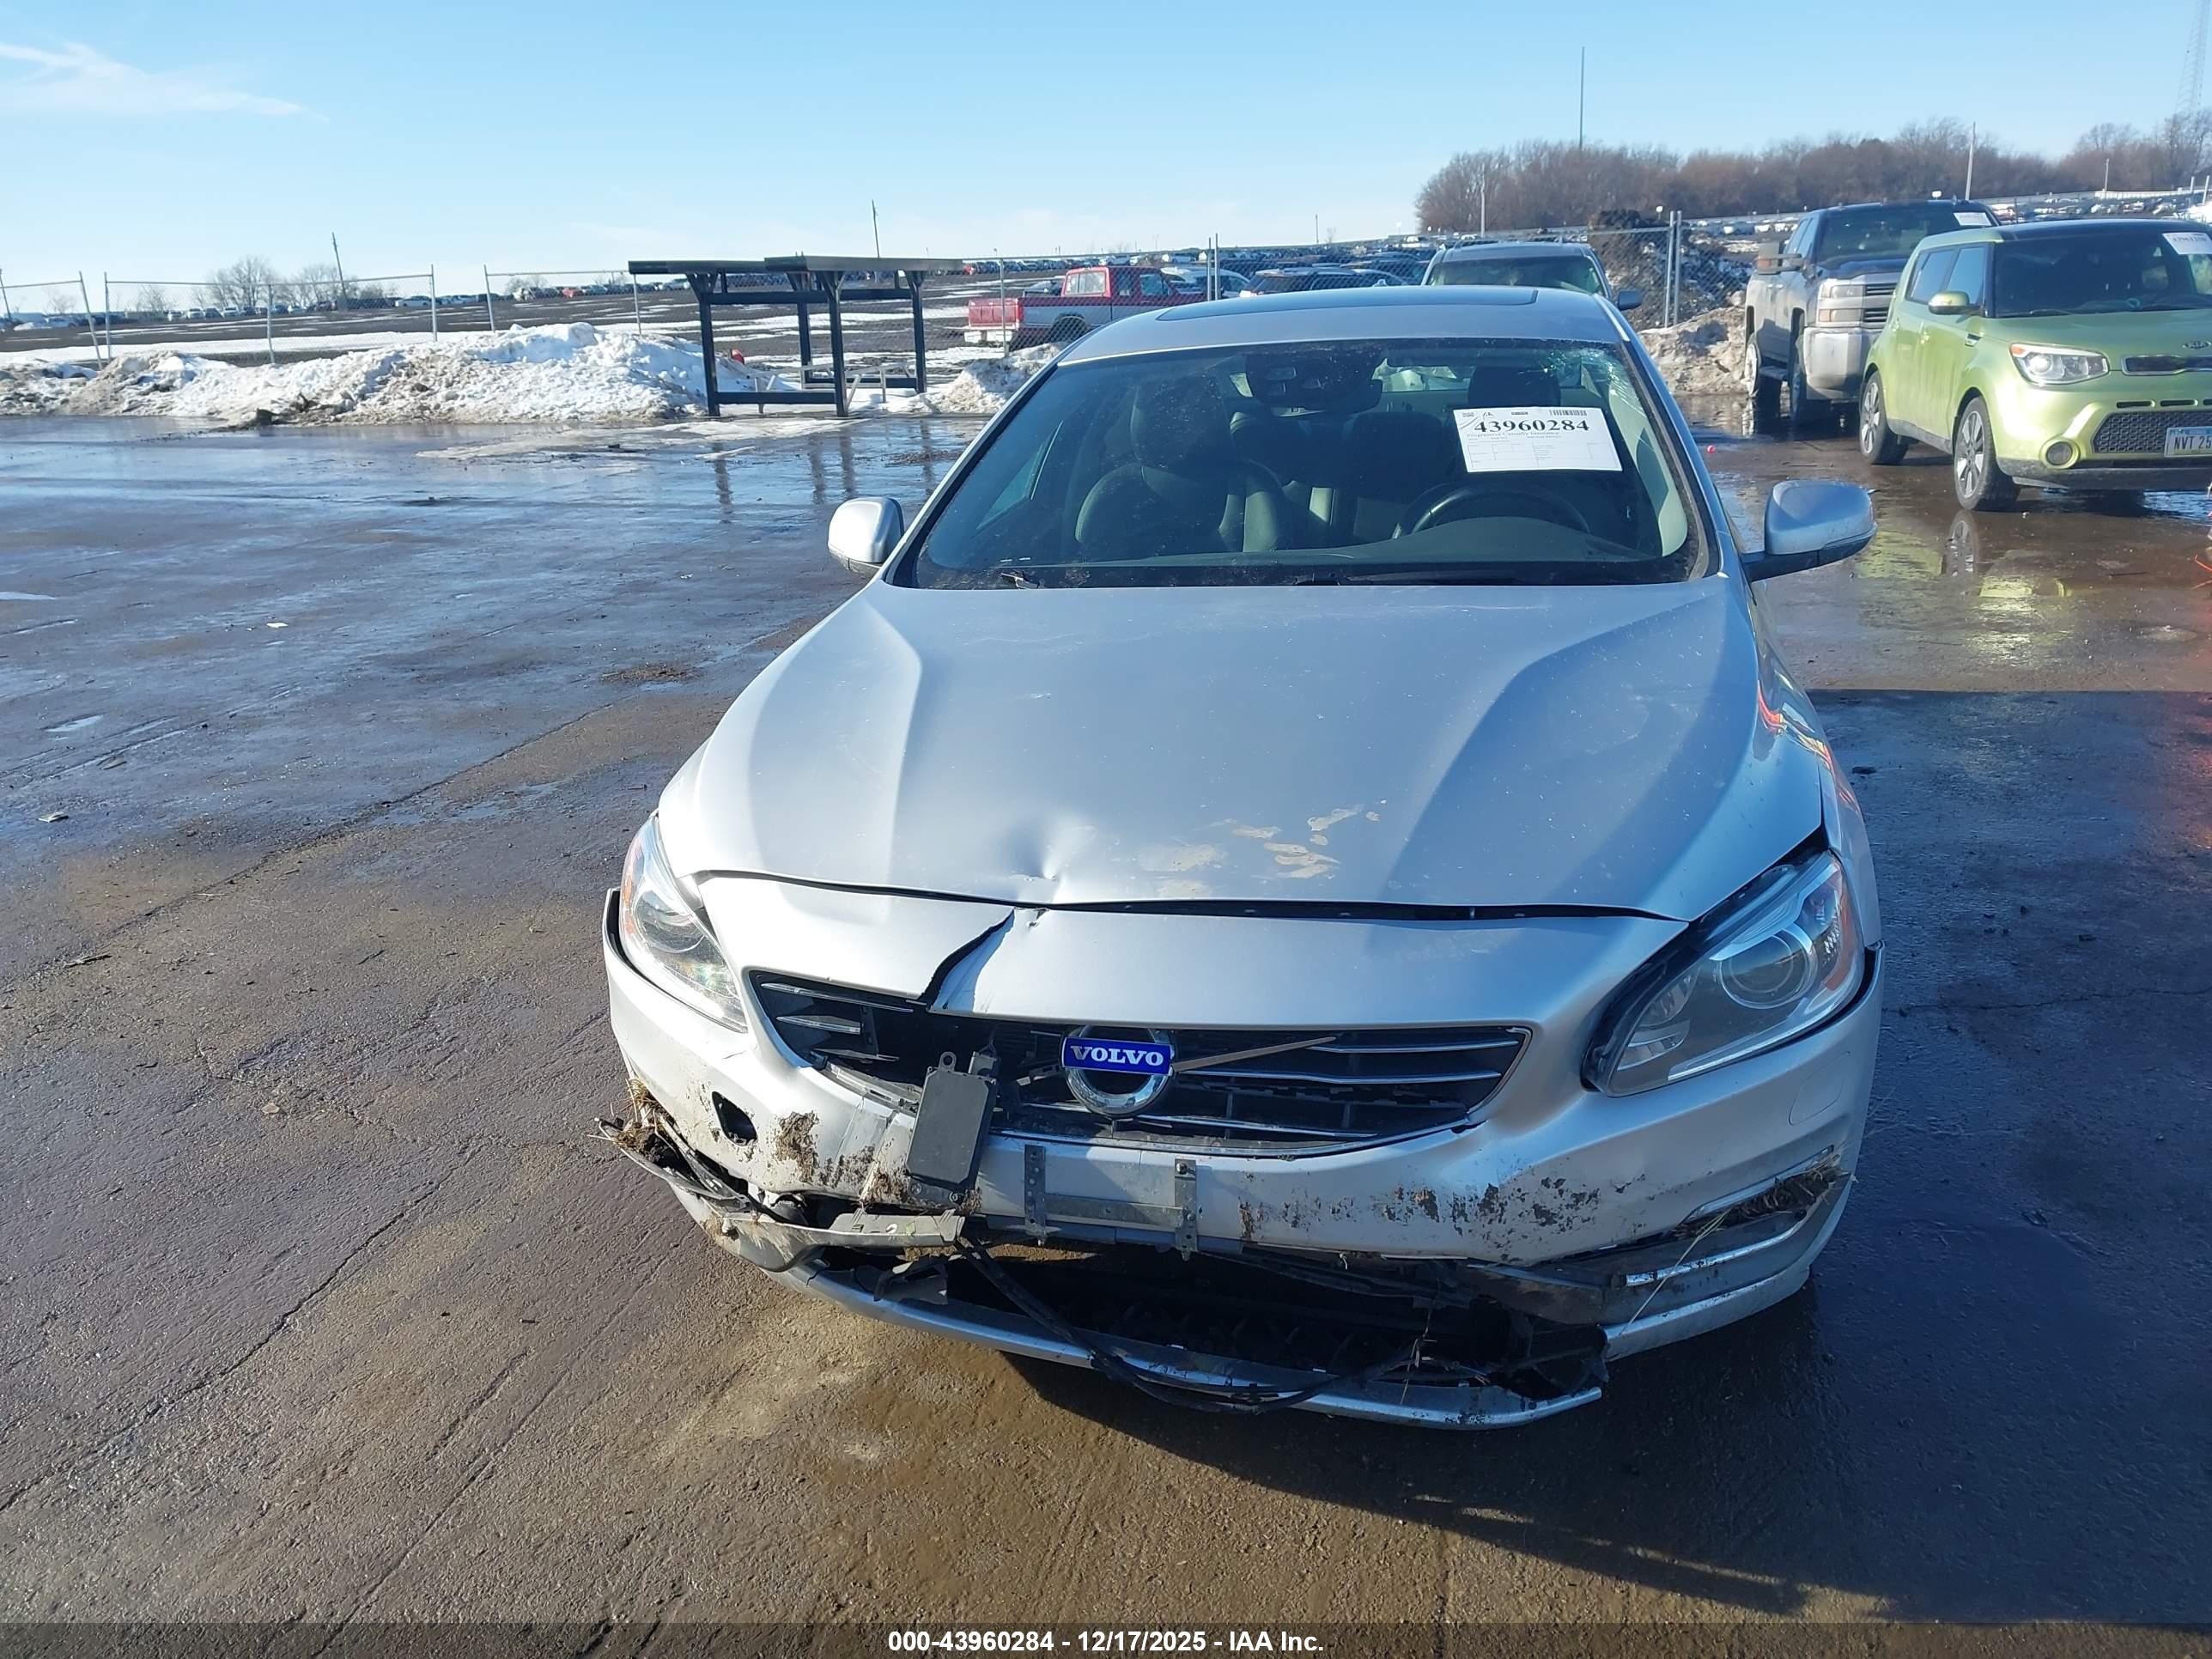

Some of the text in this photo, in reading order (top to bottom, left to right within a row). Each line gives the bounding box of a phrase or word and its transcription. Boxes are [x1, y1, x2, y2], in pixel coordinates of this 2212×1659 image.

[1474, 419, 1590, 433] 43960284
[2173, 435, 2195, 451] NVT
[1070, 1045, 1164, 1066] VOLVO
